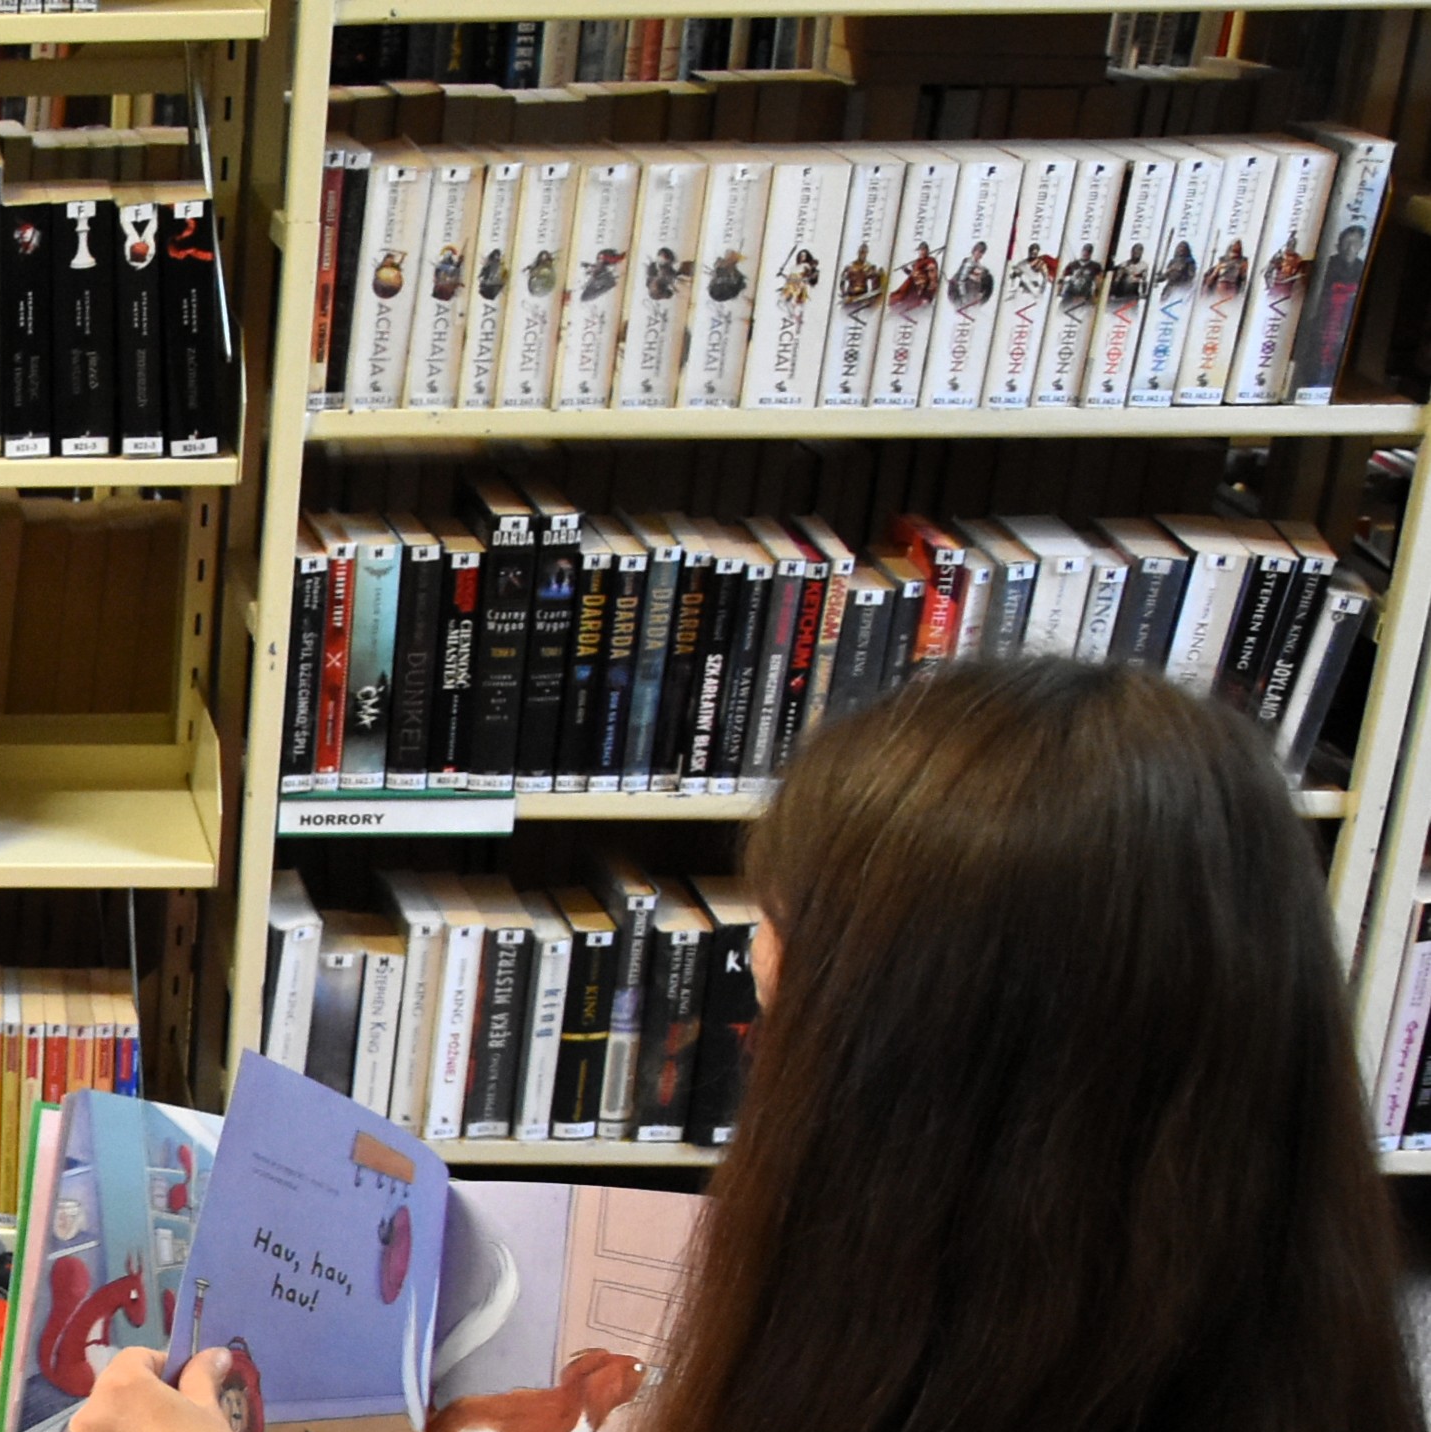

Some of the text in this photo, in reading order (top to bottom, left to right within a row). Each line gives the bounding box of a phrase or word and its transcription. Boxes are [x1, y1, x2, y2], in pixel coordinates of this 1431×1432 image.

[577, 593, 606, 658] DARDA
[610, 597, 638, 660] DARDA
[646, 587, 674, 651] DARDA
[675, 593, 704, 656] DARDA
[791, 580, 823, 670] KETCHUM
[1187, 622, 1210, 664] KING
[1236, 572, 1278, 671] STEPHEN KING
[696, 654, 724, 730] SZKARŁATNY
[1259, 658, 1294, 720] JOYLAND
[299, 814, 385, 827] HORRORY
[367, 1021, 386, 1055] KING
[488, 1012, 512, 1050] RĘKA
[253, 1226, 353, 1296] Hau, hau,
[271, 1272, 320, 1312] hau!
